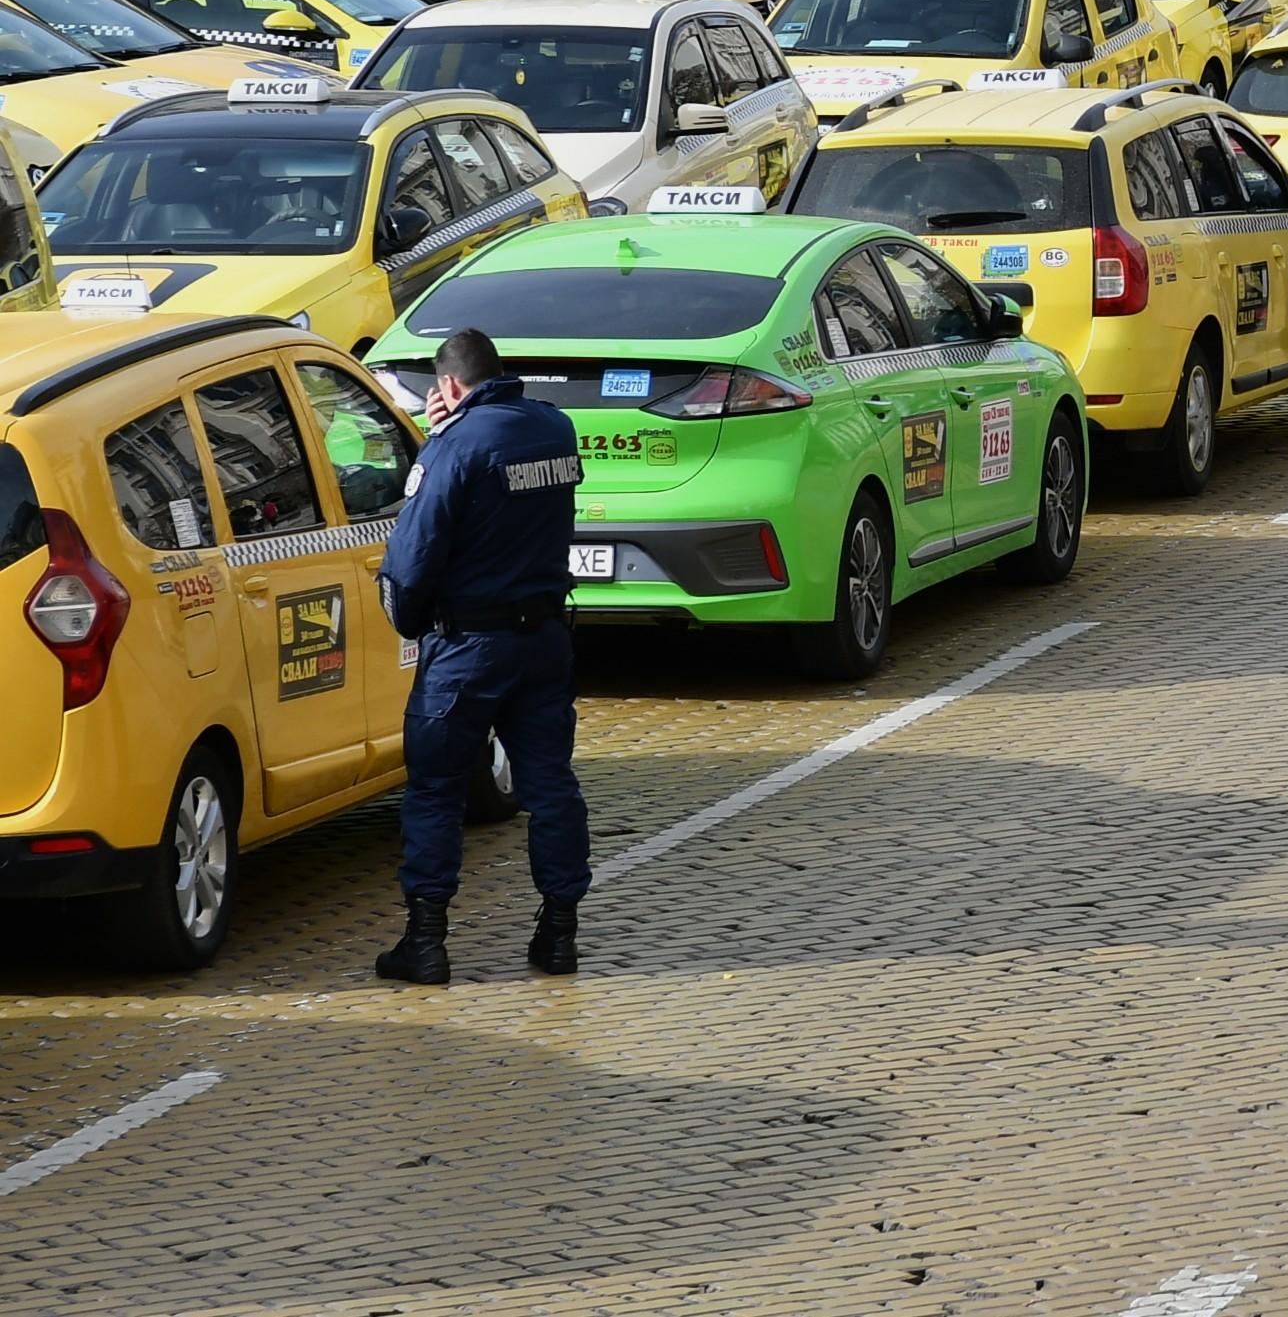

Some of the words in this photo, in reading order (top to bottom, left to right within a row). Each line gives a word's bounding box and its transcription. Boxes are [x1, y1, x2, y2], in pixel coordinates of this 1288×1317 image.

[982, 71, 1047, 82] ТАКСИ
[244, 83, 309, 95] ТАКСИ
[667, 192, 742, 205] ТАКСИ
[943, 239, 979, 247] такси
[993, 255, 1024, 269] 244308
[1045, 250, 1064, 261] BG
[77, 287, 133, 299] ТАКСИ
[782, 330, 814, 352] СВАЛИ
[792, 350, 823, 373] 91263
[607, 380, 643, 393] 246270
[636, 427, 672, 437] plug-in
[506, 460, 551, 491] SECURITY
[551, 456, 580, 484] POLICE
[163, 551, 202, 572] СВАЛИ
[174, 576, 213, 601] 91263
[281, 657, 318, 683] СВАЛИ
